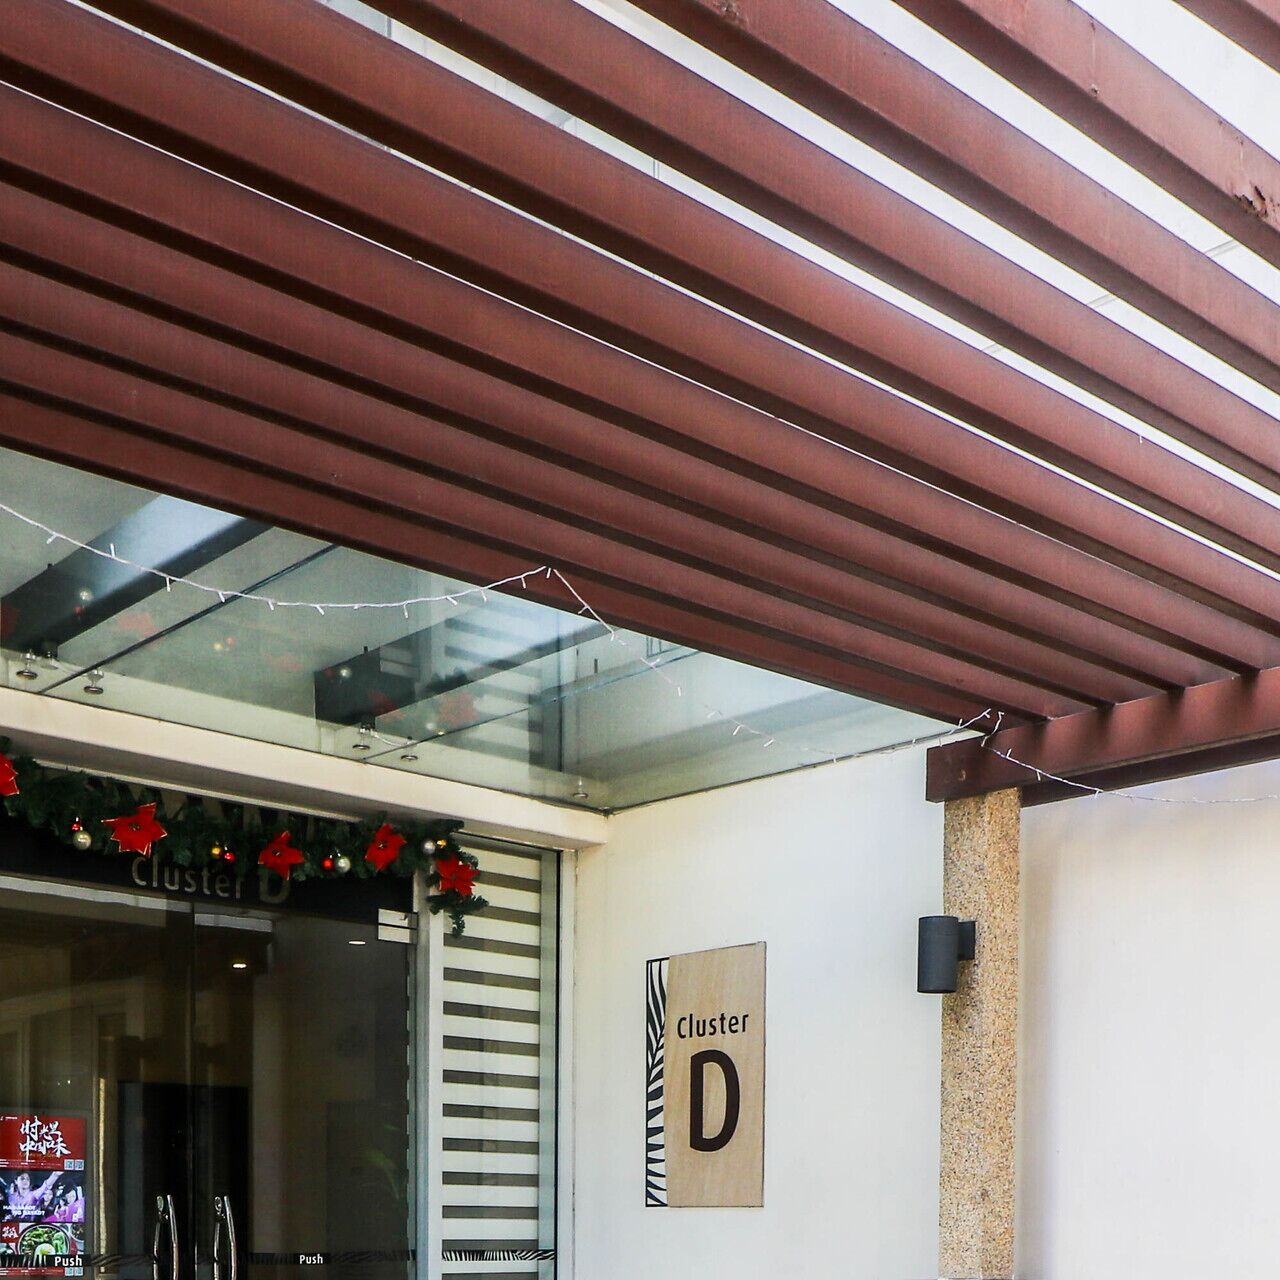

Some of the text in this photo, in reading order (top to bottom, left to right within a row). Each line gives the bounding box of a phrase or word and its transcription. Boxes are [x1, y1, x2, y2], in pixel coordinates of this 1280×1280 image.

[131, 852, 244, 899] Cluster
[676, 1012, 750, 1039] Cluster
[689, 1049, 741, 1152] D
[54, 1254, 83, 1267] Push
[299, 1253, 324, 1264] Push
